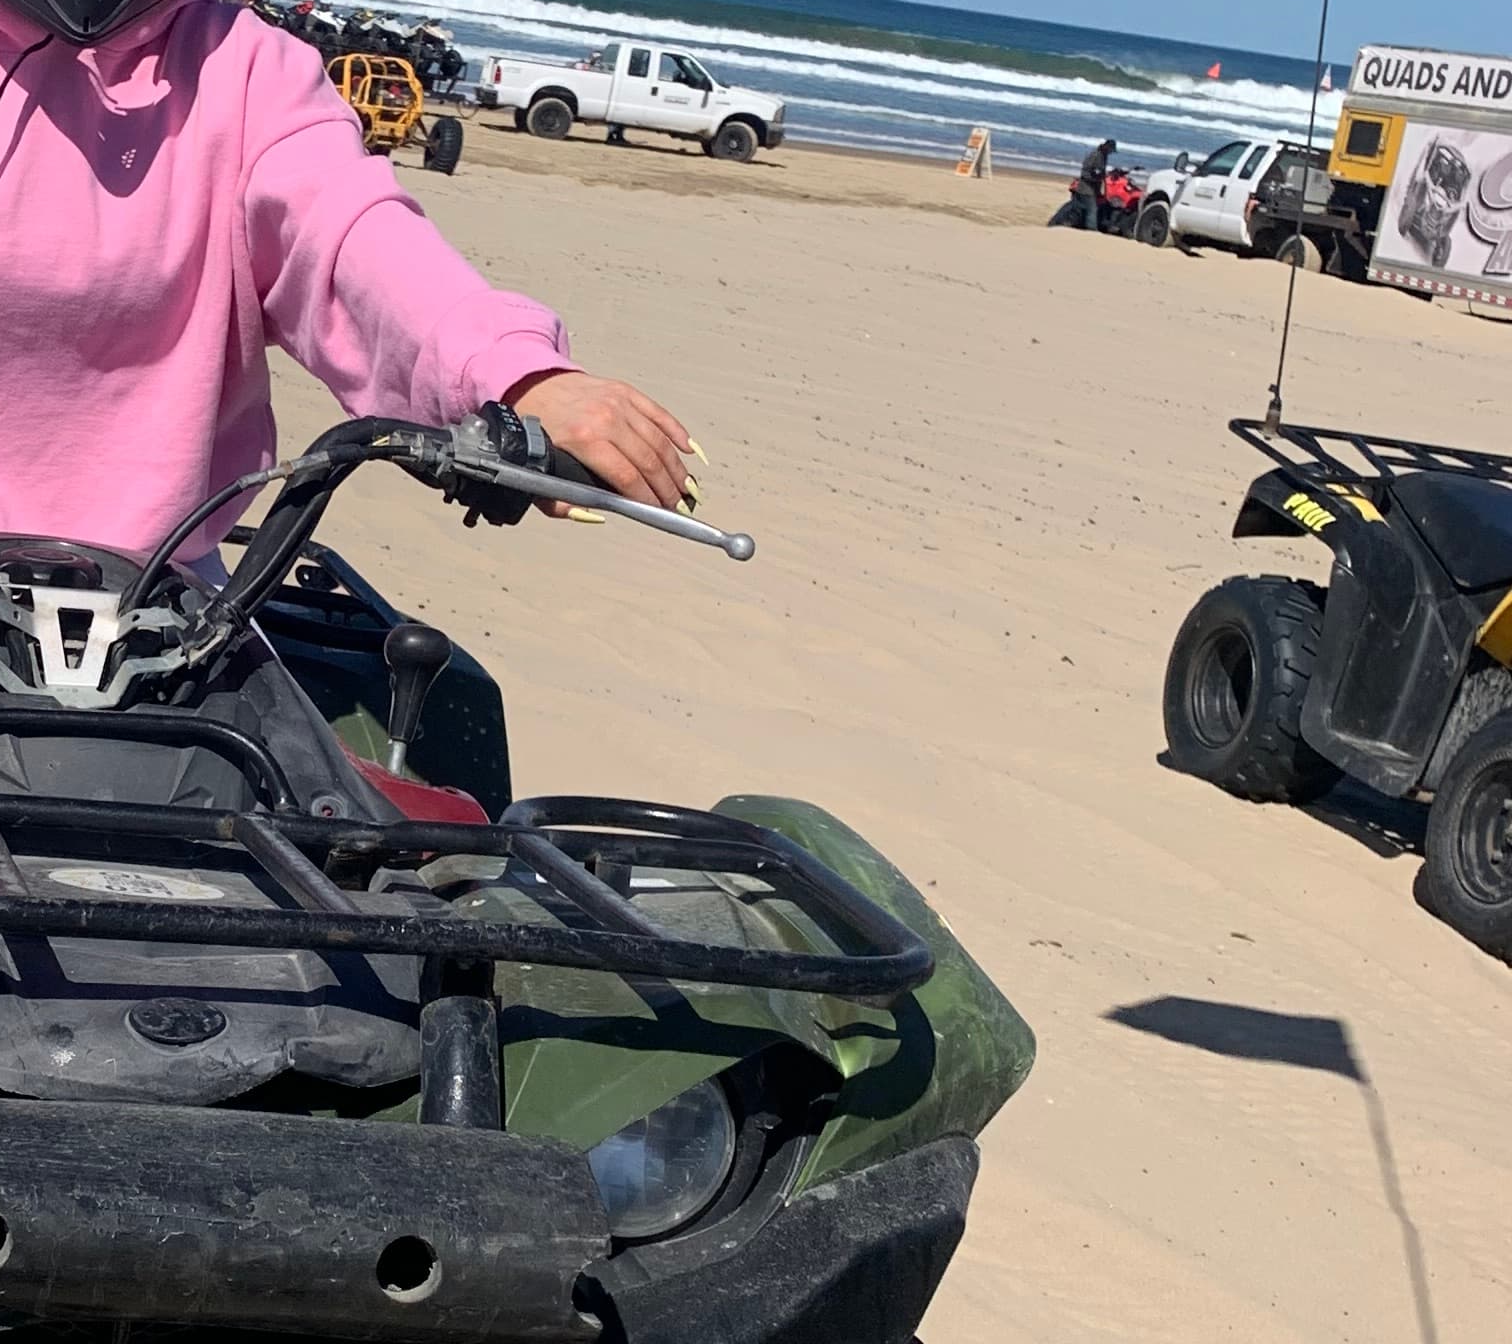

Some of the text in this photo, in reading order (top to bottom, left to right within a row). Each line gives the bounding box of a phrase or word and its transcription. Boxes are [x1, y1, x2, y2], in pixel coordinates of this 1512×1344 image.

[1363, 56, 1512, 100] QUADS AND
[1282, 492, 1337, 532] PAUL
